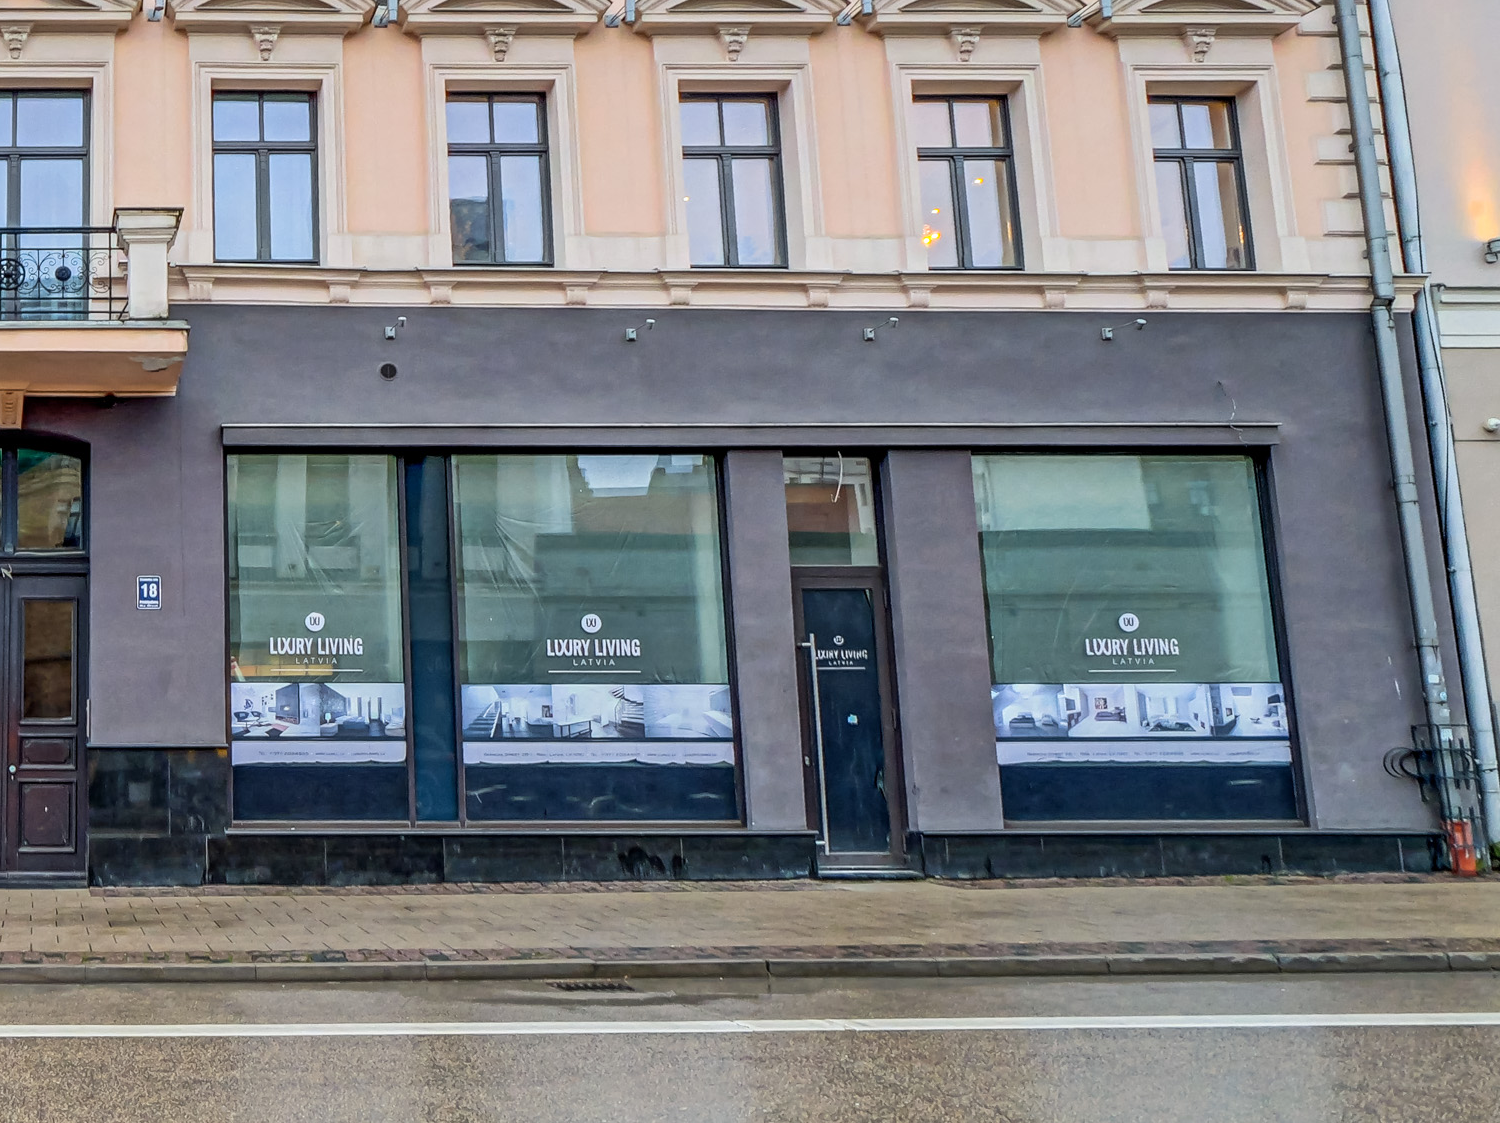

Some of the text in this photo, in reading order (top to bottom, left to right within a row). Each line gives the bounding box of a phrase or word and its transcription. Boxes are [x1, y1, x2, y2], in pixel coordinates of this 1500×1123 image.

[141, 583, 158, 598] 18
[317, 637, 364, 655] LIVING
[594, 639, 641, 657] LIVING
[1133, 638, 1180, 656] LIVING
[295, 657, 337, 665] LATVIA
[841, 649, 868, 660] LIVING
